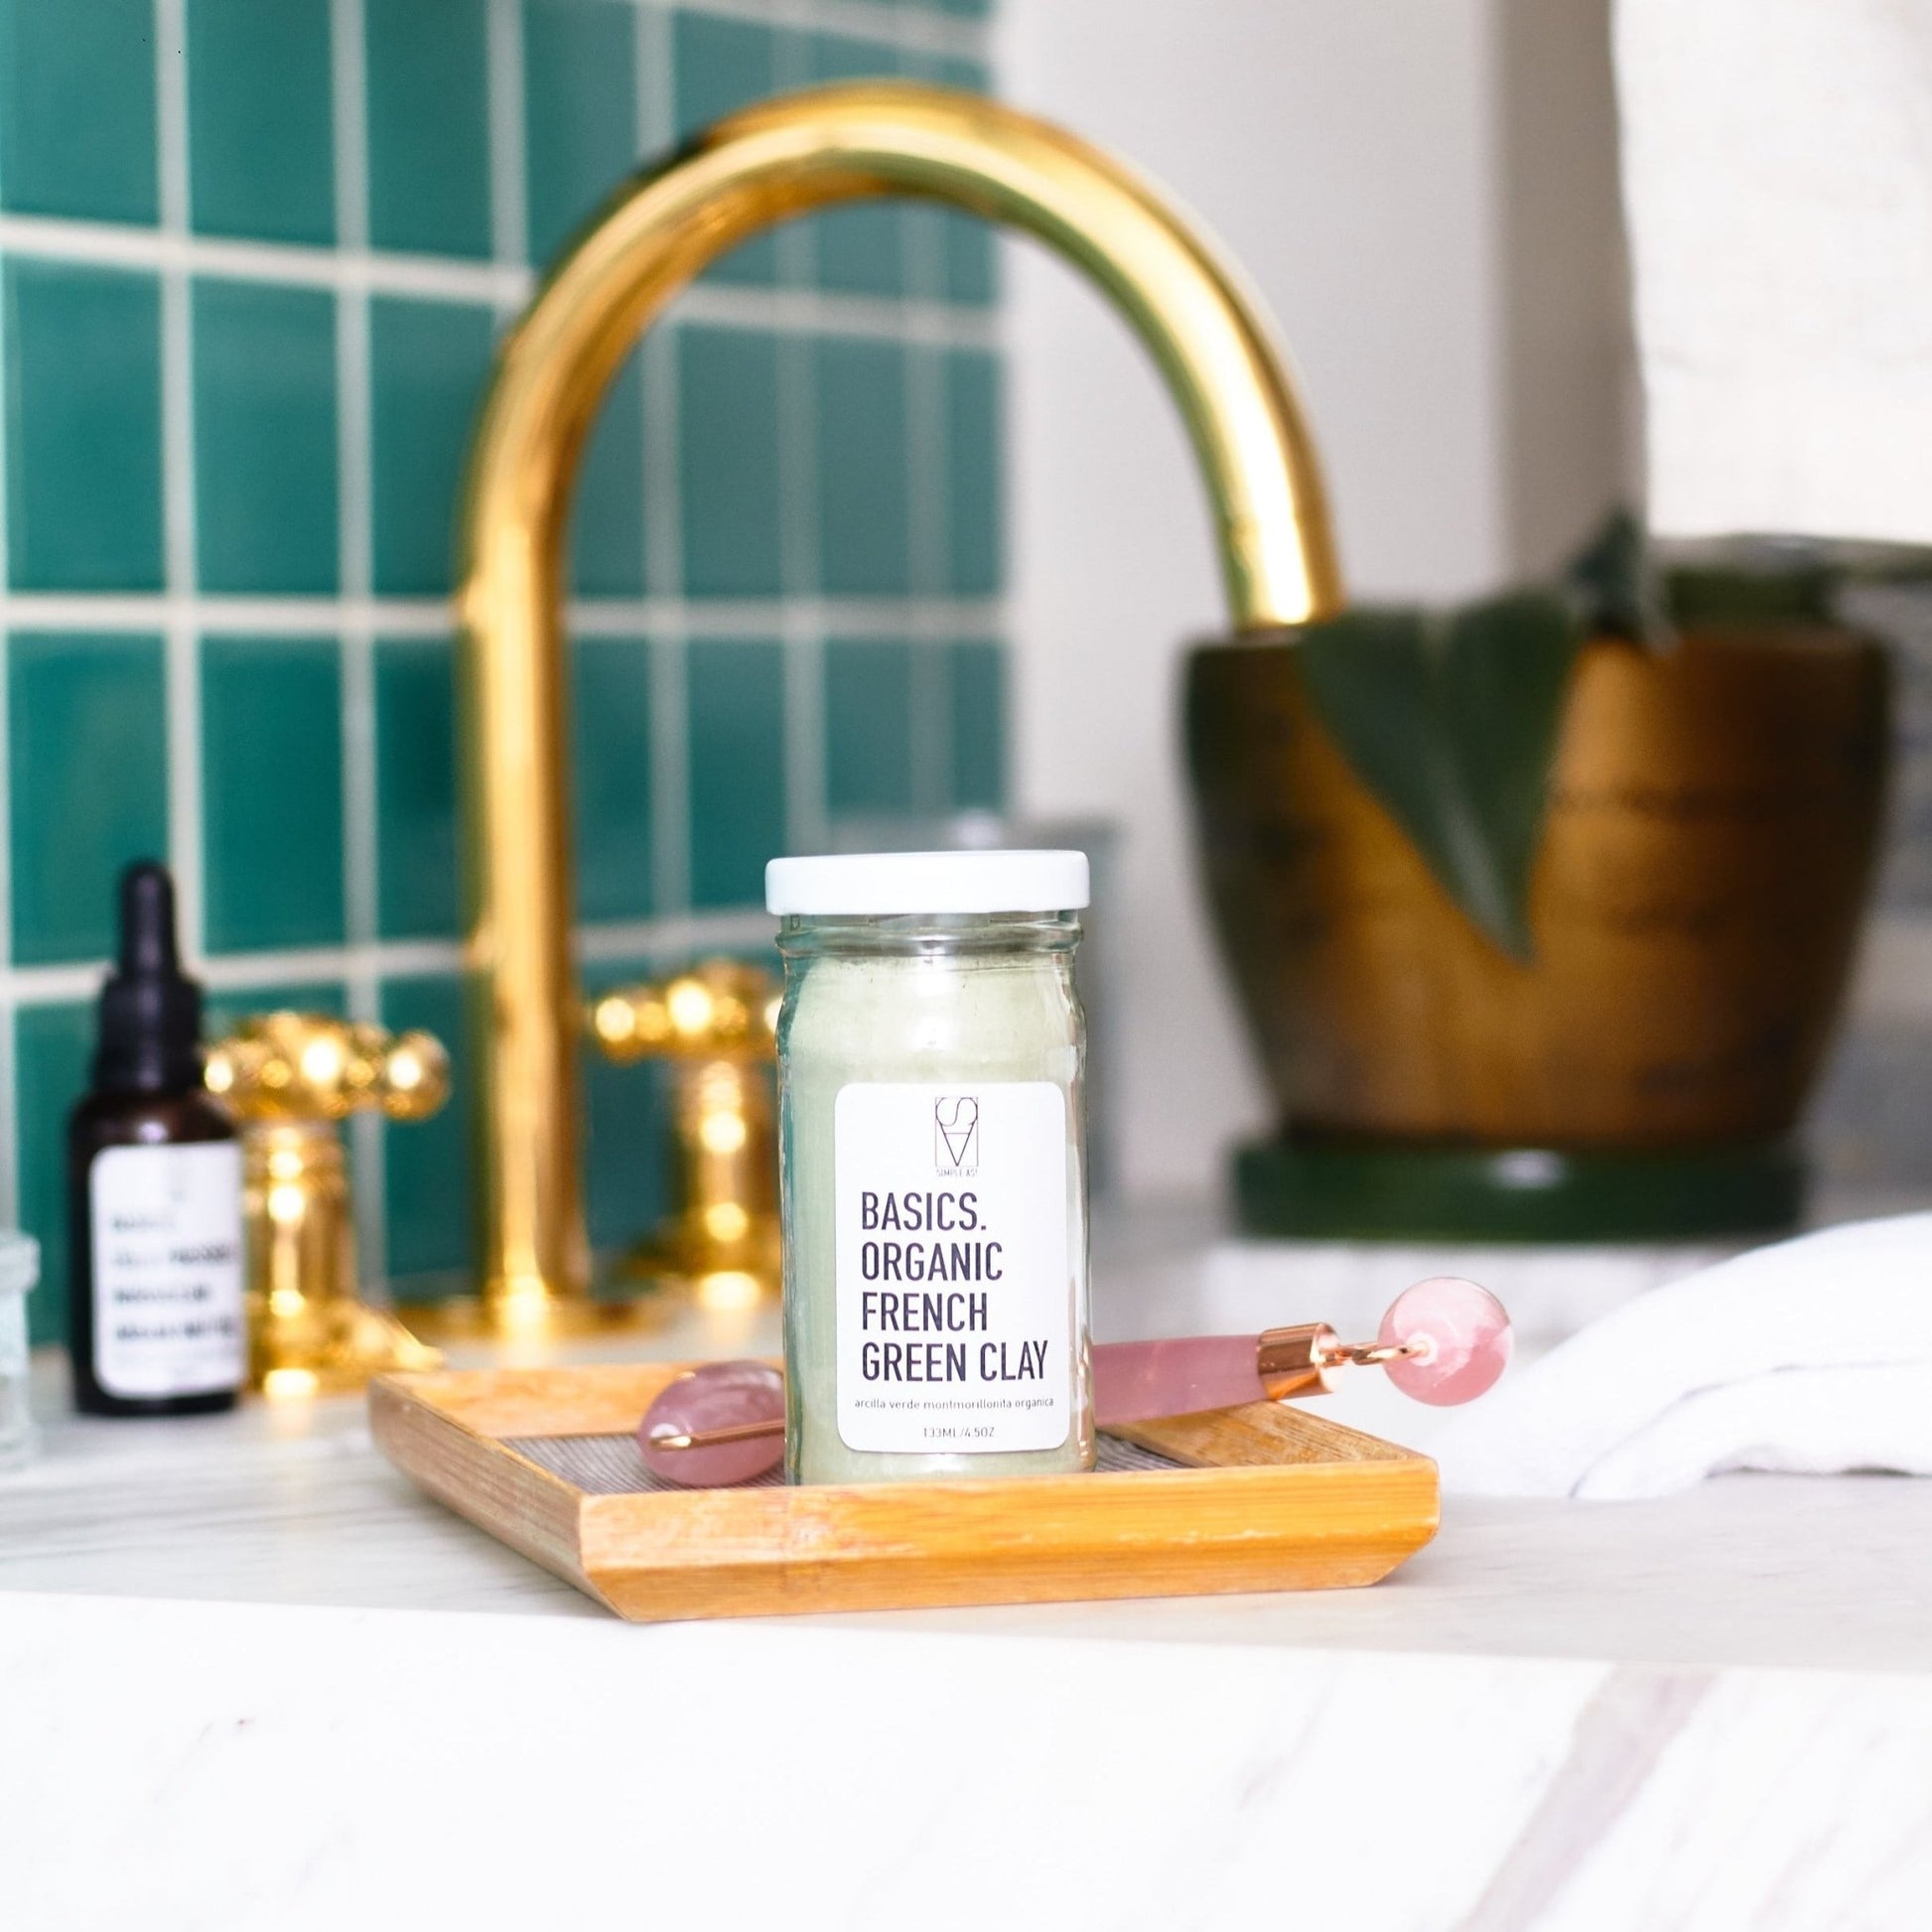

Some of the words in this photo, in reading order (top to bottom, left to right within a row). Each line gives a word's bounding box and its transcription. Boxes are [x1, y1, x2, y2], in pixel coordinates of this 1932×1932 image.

[862, 1191, 987, 1231] BASICS.
[862, 1242, 1003, 1281] ORGANIC
[862, 1292, 988, 1331] FRENCH
[862, 1342, 967, 1382] GREEN
[980, 1339, 1048, 1381] CLAY
[854, 1398, 887, 1409] arcilla
[889, 1399, 920, 1410] verde
[923, 1398, 1012, 1410] montmorillonita
[1015, 1397, 1054, 1410] organica
